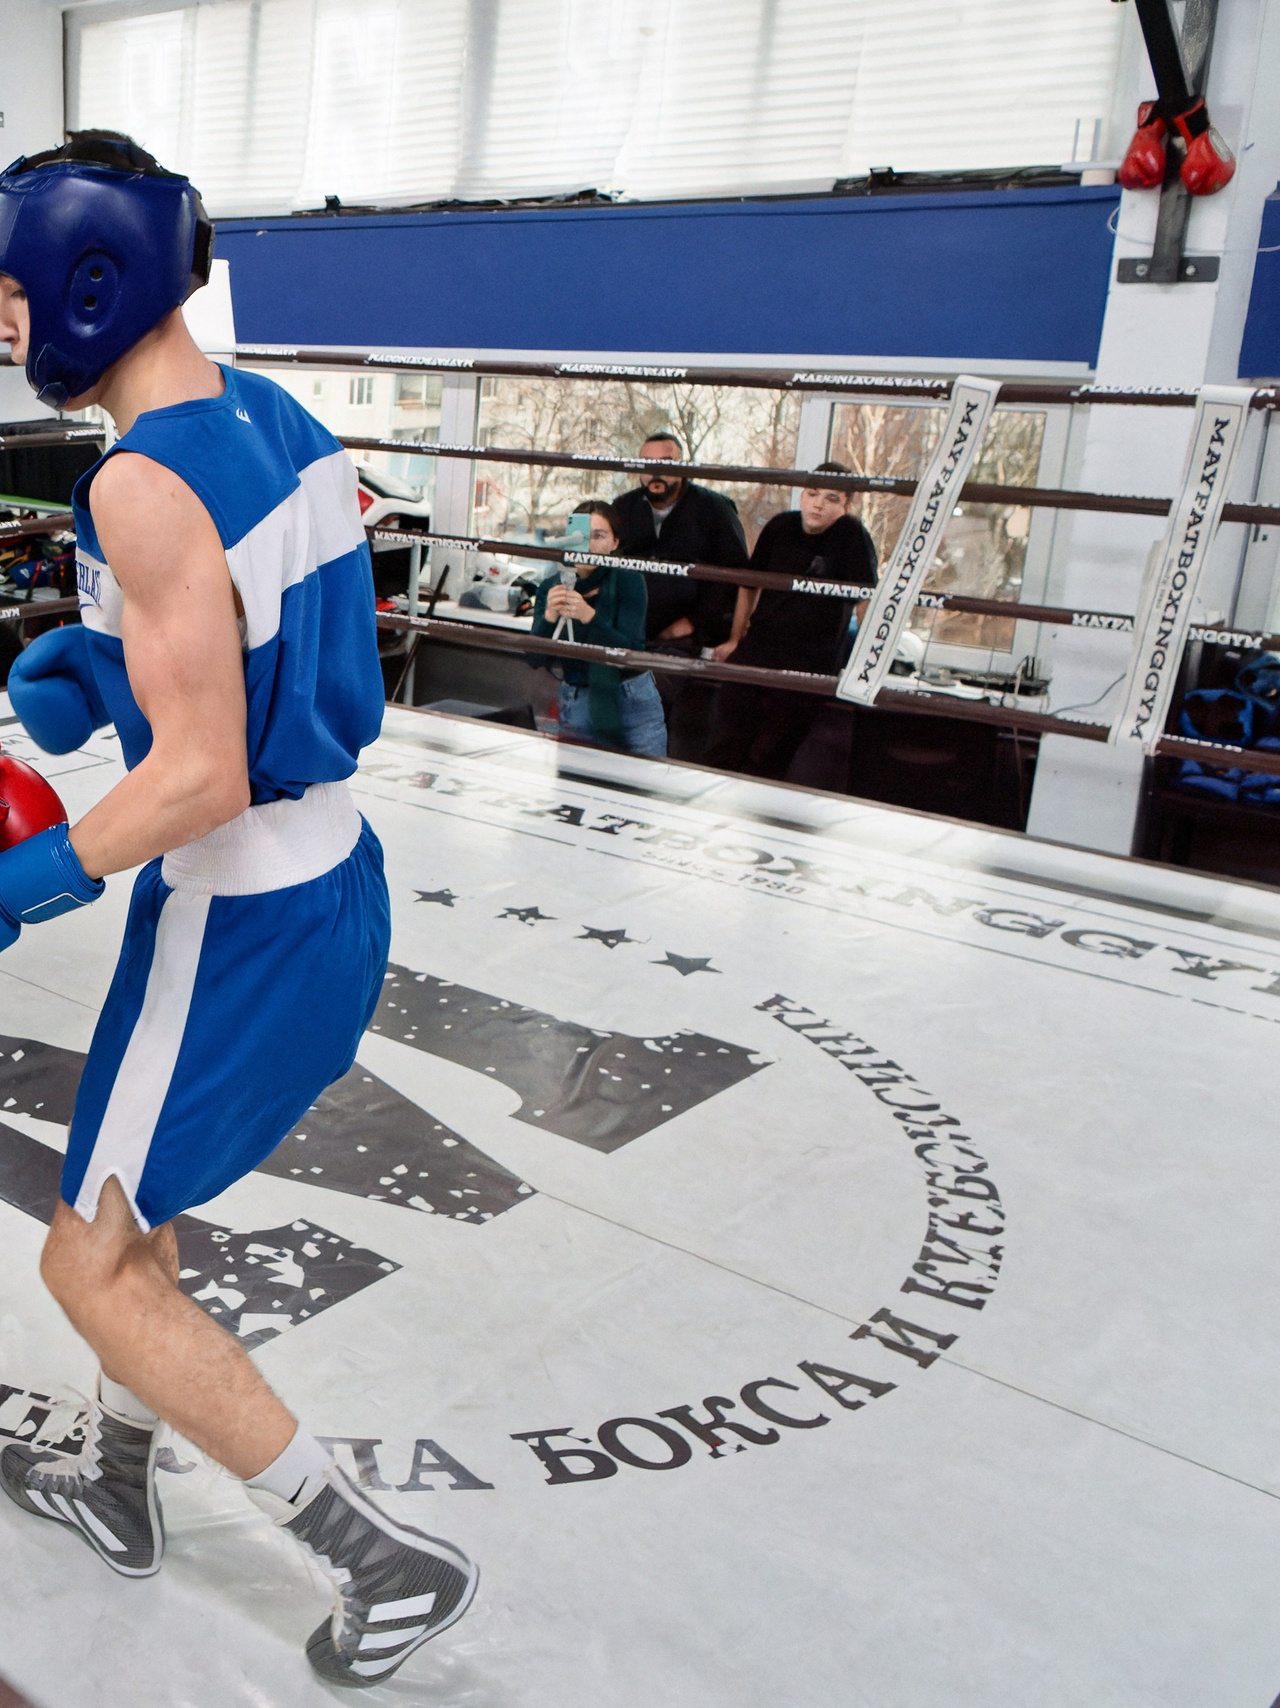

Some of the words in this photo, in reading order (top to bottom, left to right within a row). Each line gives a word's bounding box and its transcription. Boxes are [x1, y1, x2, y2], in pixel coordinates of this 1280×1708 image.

[564, 552, 689, 576] MAYFATBOXINGGYM
[857, 401, 979, 684] MAYFATBOXINGGYM
[1129, 416, 1231, 740] MAYFATBOXINGGYM
[509, 1360, 900, 1486] БОКСА
[848, 1307, 961, 1370] И
